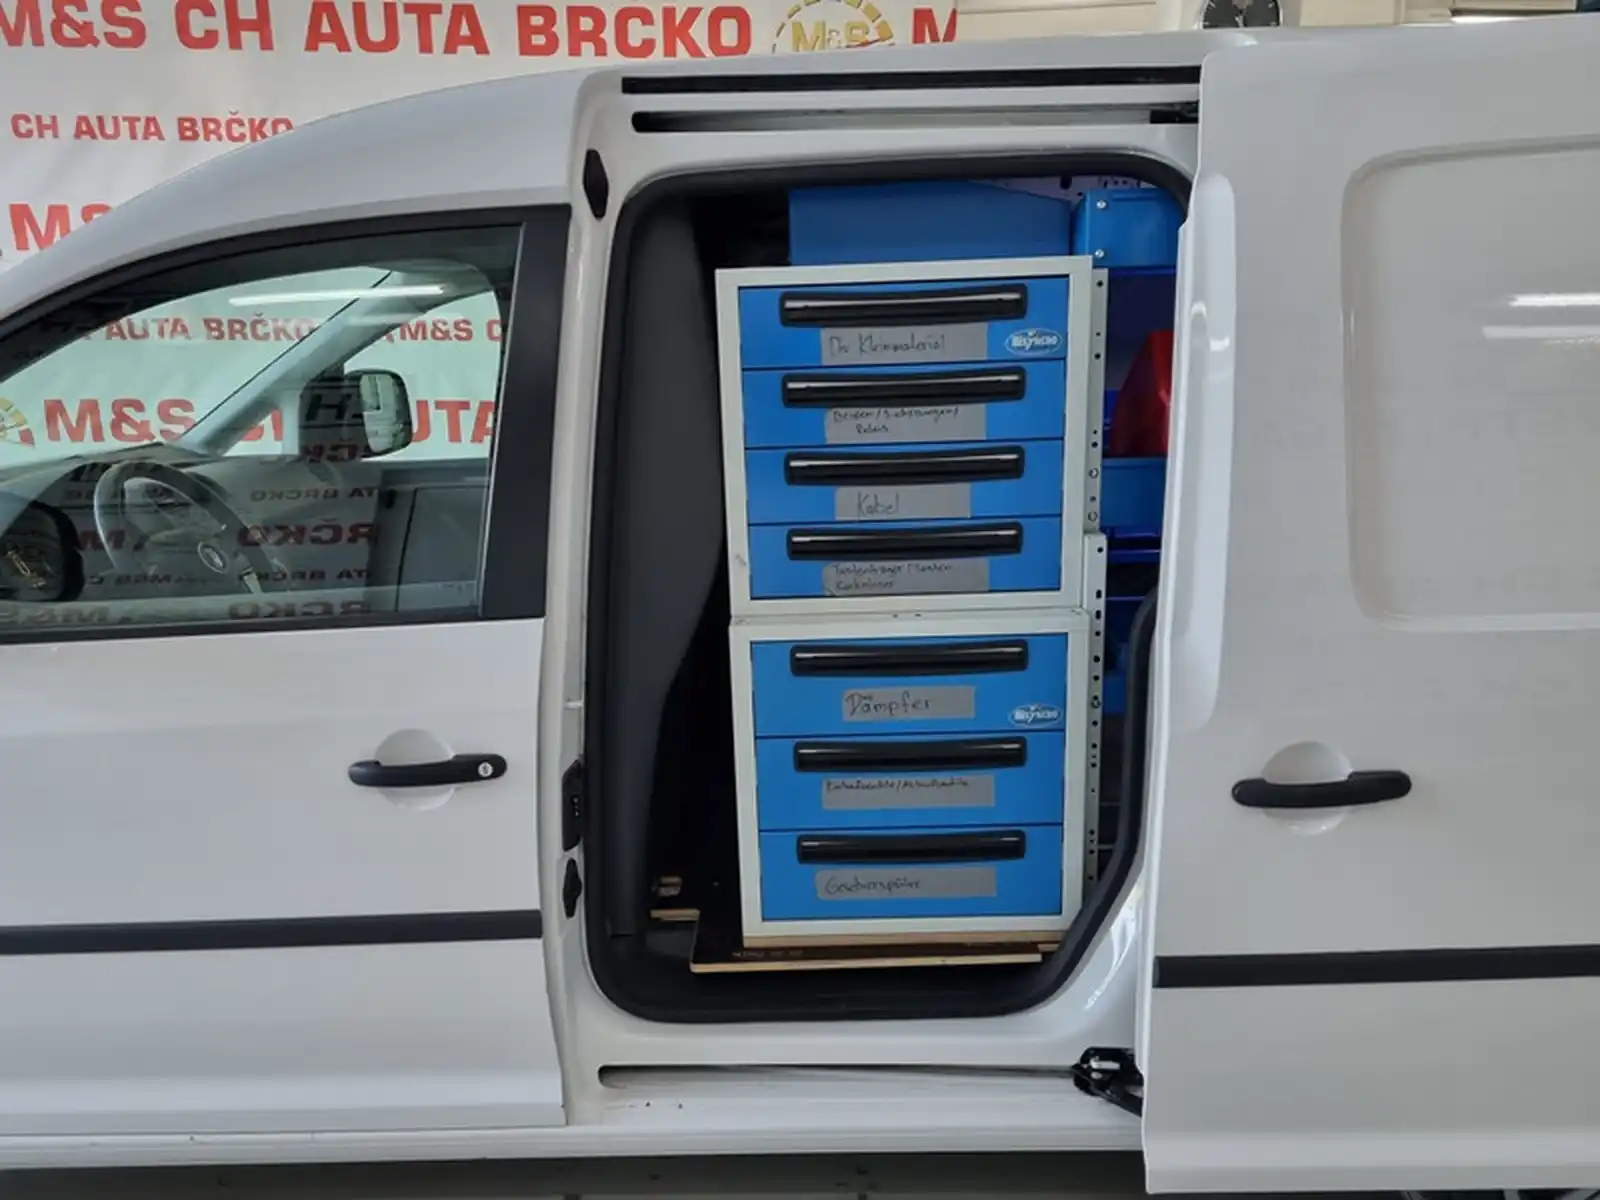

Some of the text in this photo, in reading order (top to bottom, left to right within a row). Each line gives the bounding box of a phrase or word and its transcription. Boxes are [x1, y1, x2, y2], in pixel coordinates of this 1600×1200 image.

[175, 0, 274, 51] CH
[304, 2, 490, 56] AUTA
[11, 113, 59, 139] CH
[73, 115, 165, 141] AUTA
[105, 317, 192, 341] AUTA
[400, 319, 473, 342] M&S
[44, 398, 196, 443] M&S
